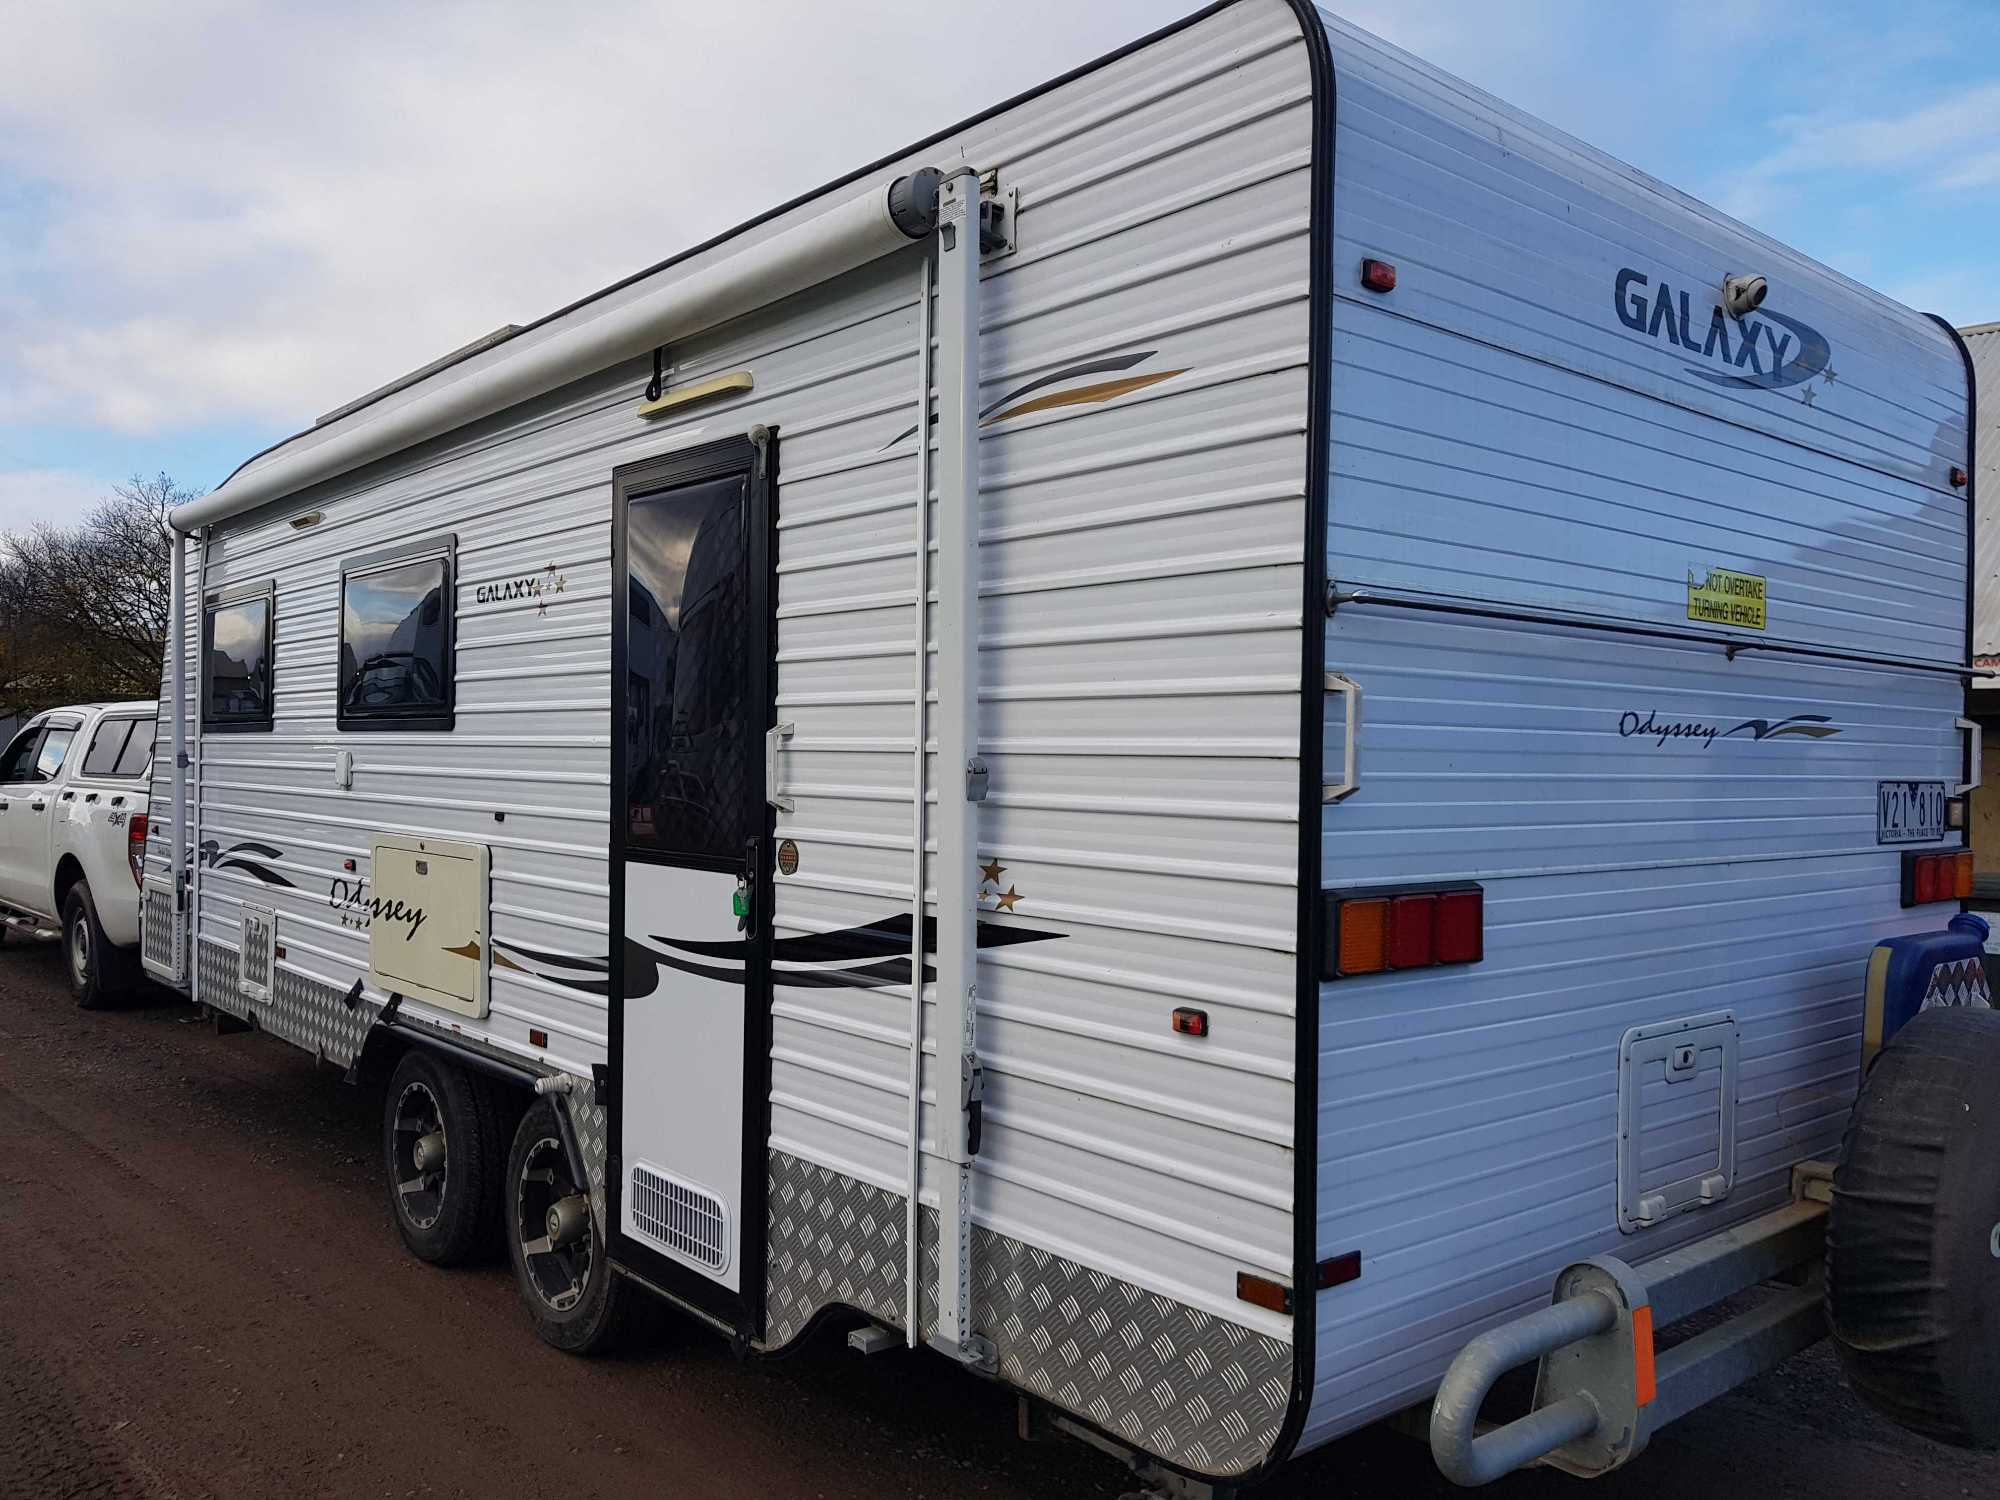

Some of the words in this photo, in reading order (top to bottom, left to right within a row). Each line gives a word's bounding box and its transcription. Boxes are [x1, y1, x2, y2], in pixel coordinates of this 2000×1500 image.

[1614, 267, 1792, 382] GALAXY
[476, 578, 536, 604] GALAXY
[1705, 573, 1722, 592] NOT
[1724, 575, 1763, 600] OVERTAKE
[1693, 597, 1728, 620] TURNING
[1730, 603, 1761, 625] VEHICLE
[1618, 709, 1720, 749] Odyssey
[329, 877, 428, 941] Odyssey
